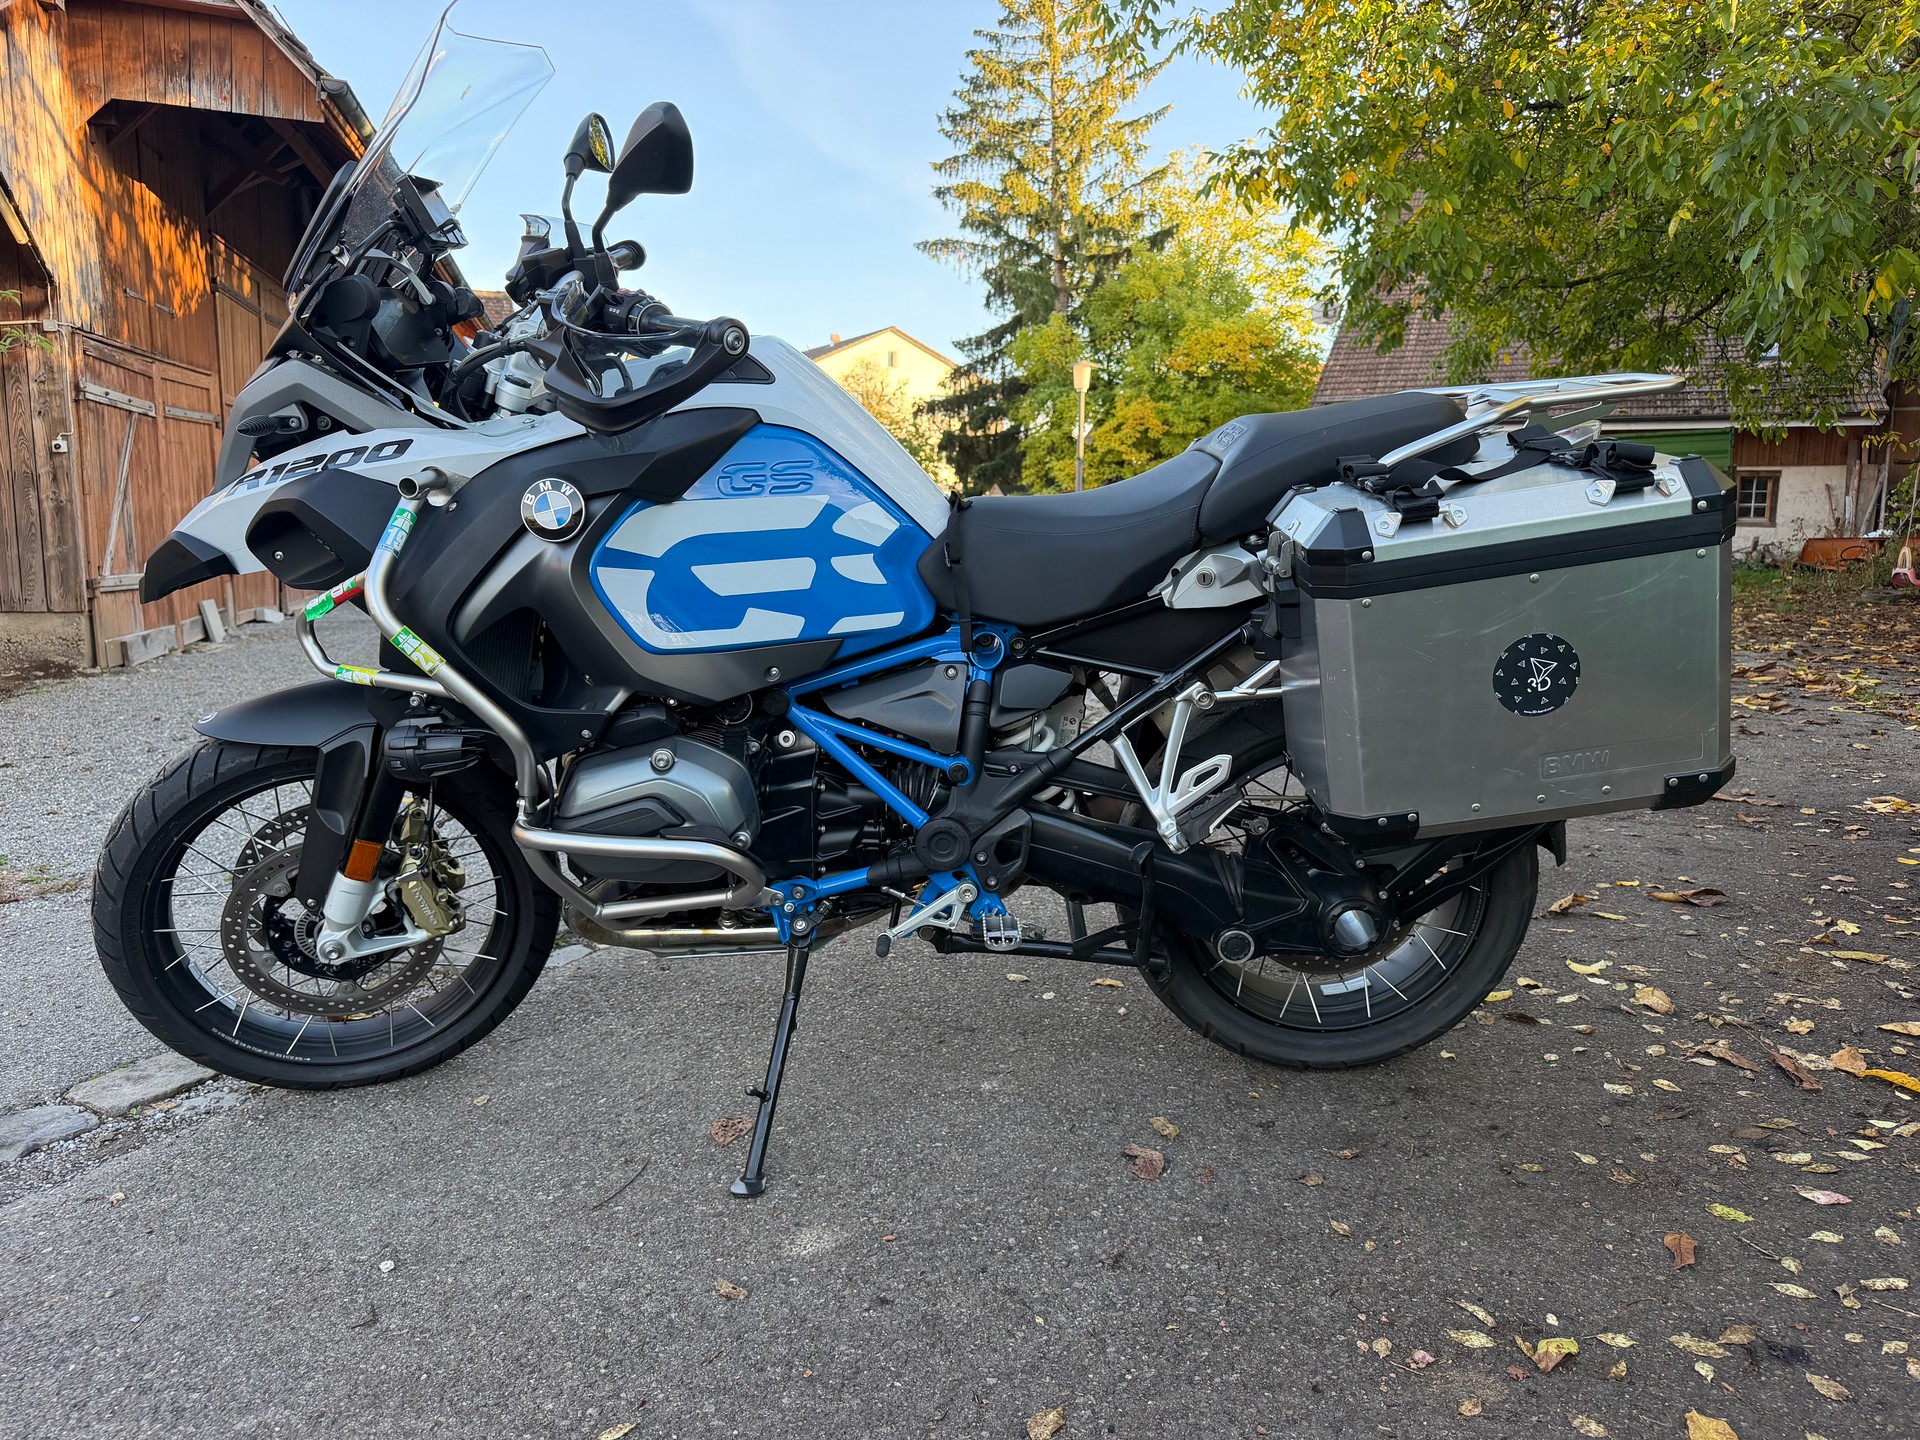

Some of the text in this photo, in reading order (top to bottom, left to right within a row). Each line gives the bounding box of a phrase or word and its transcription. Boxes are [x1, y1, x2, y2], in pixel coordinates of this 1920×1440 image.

[225, 438, 414, 498] R1200
[717, 460, 815, 497] GS
[523, 480, 575, 506] BMW
[411, 643, 441, 671] 21
[1543, 748, 1611, 778] BMW
